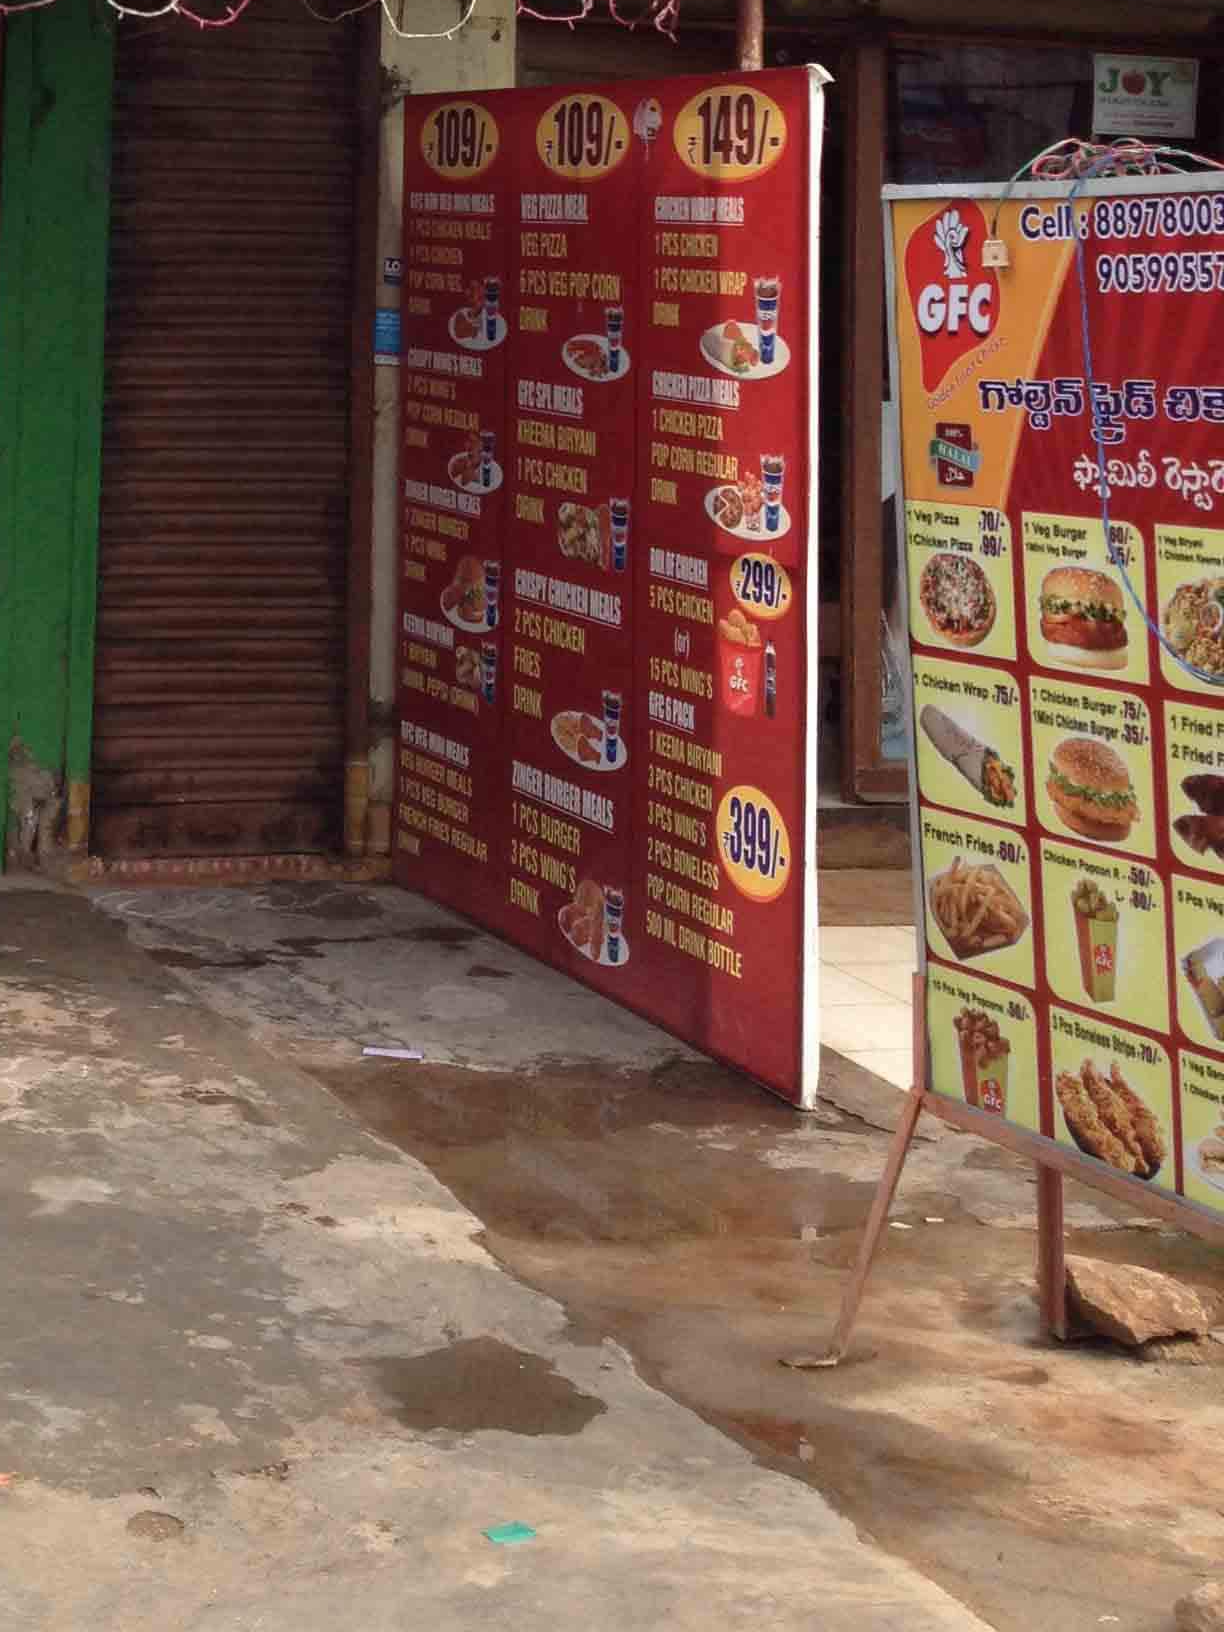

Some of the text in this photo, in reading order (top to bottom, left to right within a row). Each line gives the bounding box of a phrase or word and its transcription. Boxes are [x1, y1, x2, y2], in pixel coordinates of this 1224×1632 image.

[1020, 205, 1072, 240] Cell
[520, 232, 569, 257] VEG PIZZA
[549, 271, 568, 296] VEG
[569, 272, 590, 297] POP
[592, 273, 621, 302] CORN
[917, 282, 993, 334] GFC
[698, 413, 724, 441] PIZZA
[525, 457, 588, 495] PCS CHICKEN
[913, 509, 960, 526] Veg Pizza
[1033, 522, 1087, 542] Veg Burger
[913, 533, 948, 548] Chicken
[589, 588, 621, 625] MEALS
[657, 586, 714, 625] PCS CHICKEN
[522, 610, 585, 656] PCS CHICKEN
[513, 645, 541, 679] FRIES
[661, 658, 680, 688] PCS
[921, 673, 989, 700] Chicken Wrap
[1040, 689, 1118, 716] Chicken Burger
[1056, 714, 1119, 741] Chicken Burger
[1181, 716, 1213, 737] Fried
[1181, 745, 1214, 766] Fried
[544, 773, 581, 814] BURGER
[582, 788, 615, 830] MEALS
[655, 767, 713, 810] PCS CHICKEN
[519, 804, 581, 857] PCS BURGER
[654, 804, 673, 833] PCS
[923, 823, 995, 856] French Fries
[519, 842, 538, 873] PCS
[654, 839, 720, 891] PCS BONELESS
[1043, 849, 1077, 869] Chicken
[510, 877, 540, 917] DRINK
[647, 873, 734, 936] POP CORN REGULAR
[646, 910, 743, 979] 500 ML DRINK BOTTLE
